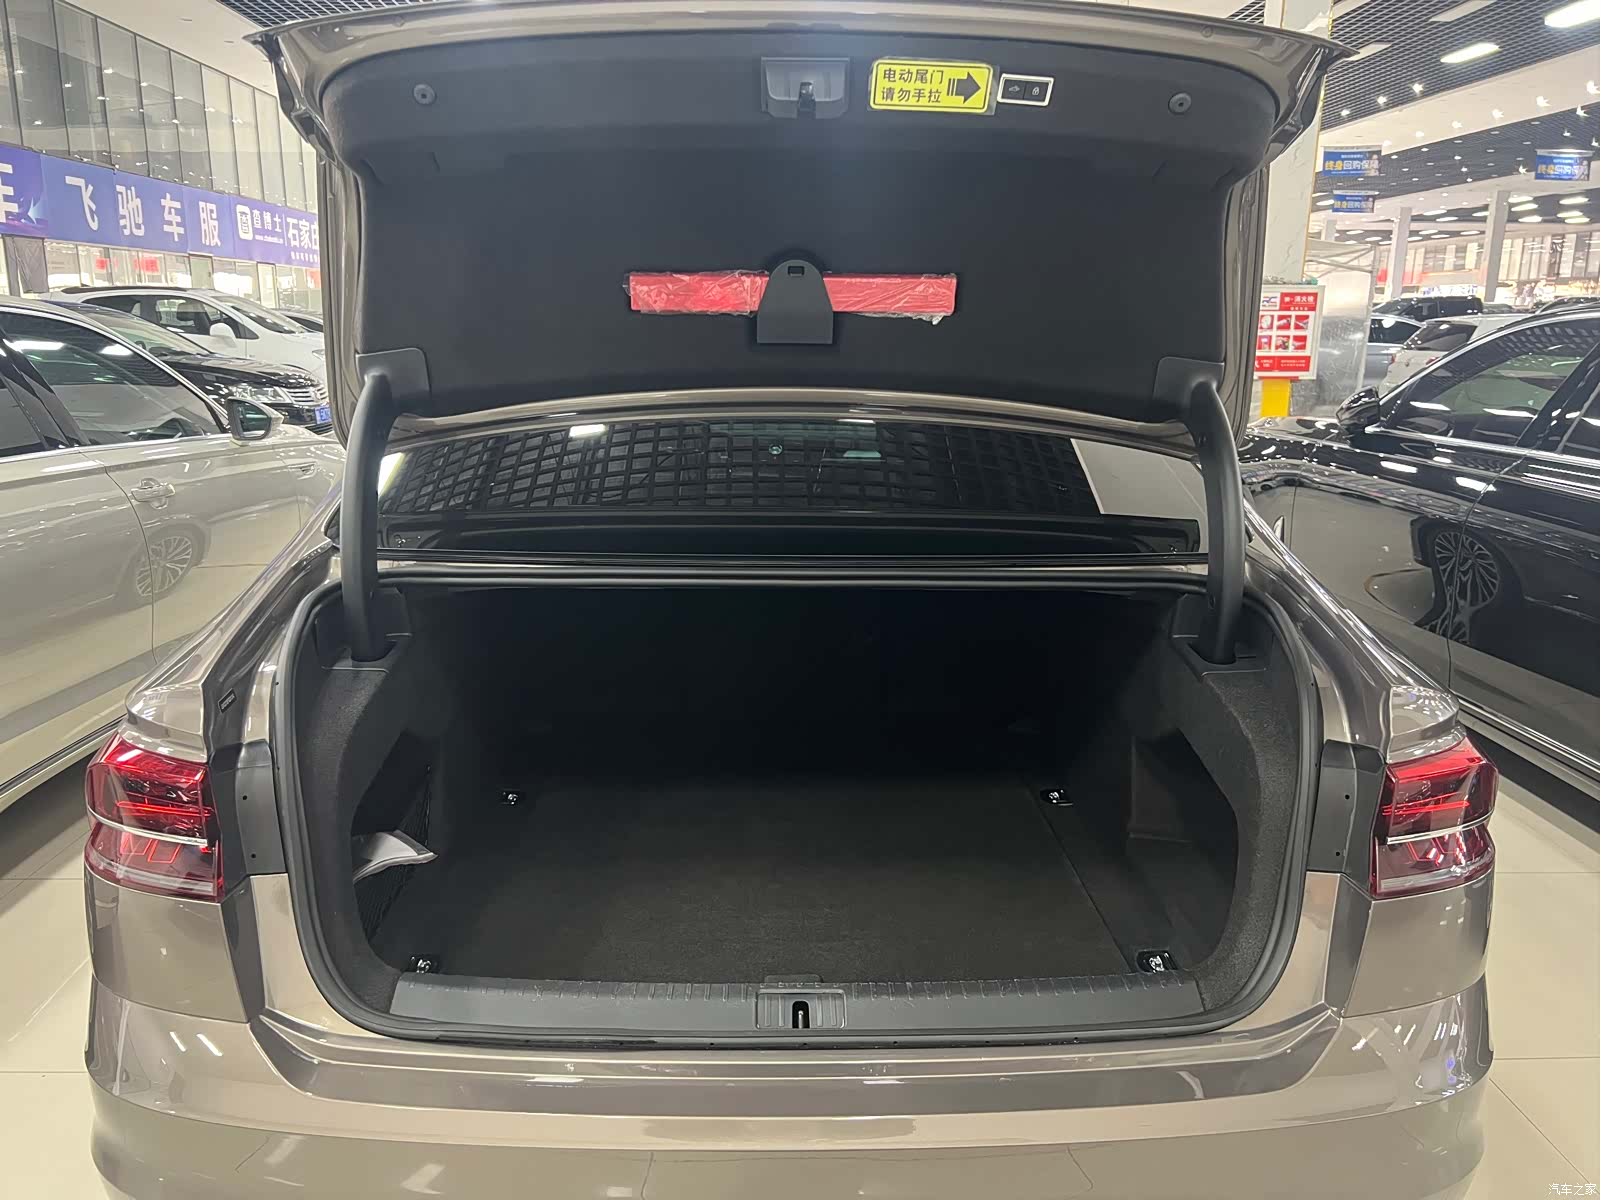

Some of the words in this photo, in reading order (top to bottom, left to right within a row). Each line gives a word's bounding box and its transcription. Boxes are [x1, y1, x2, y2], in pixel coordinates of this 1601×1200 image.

[883, 67, 944, 85] 电动尾门
[881, 86, 942, 104] 请勿手拉
[65, 175, 222, 247] 飞驰车服
[252, 208, 282, 233] 查博士
